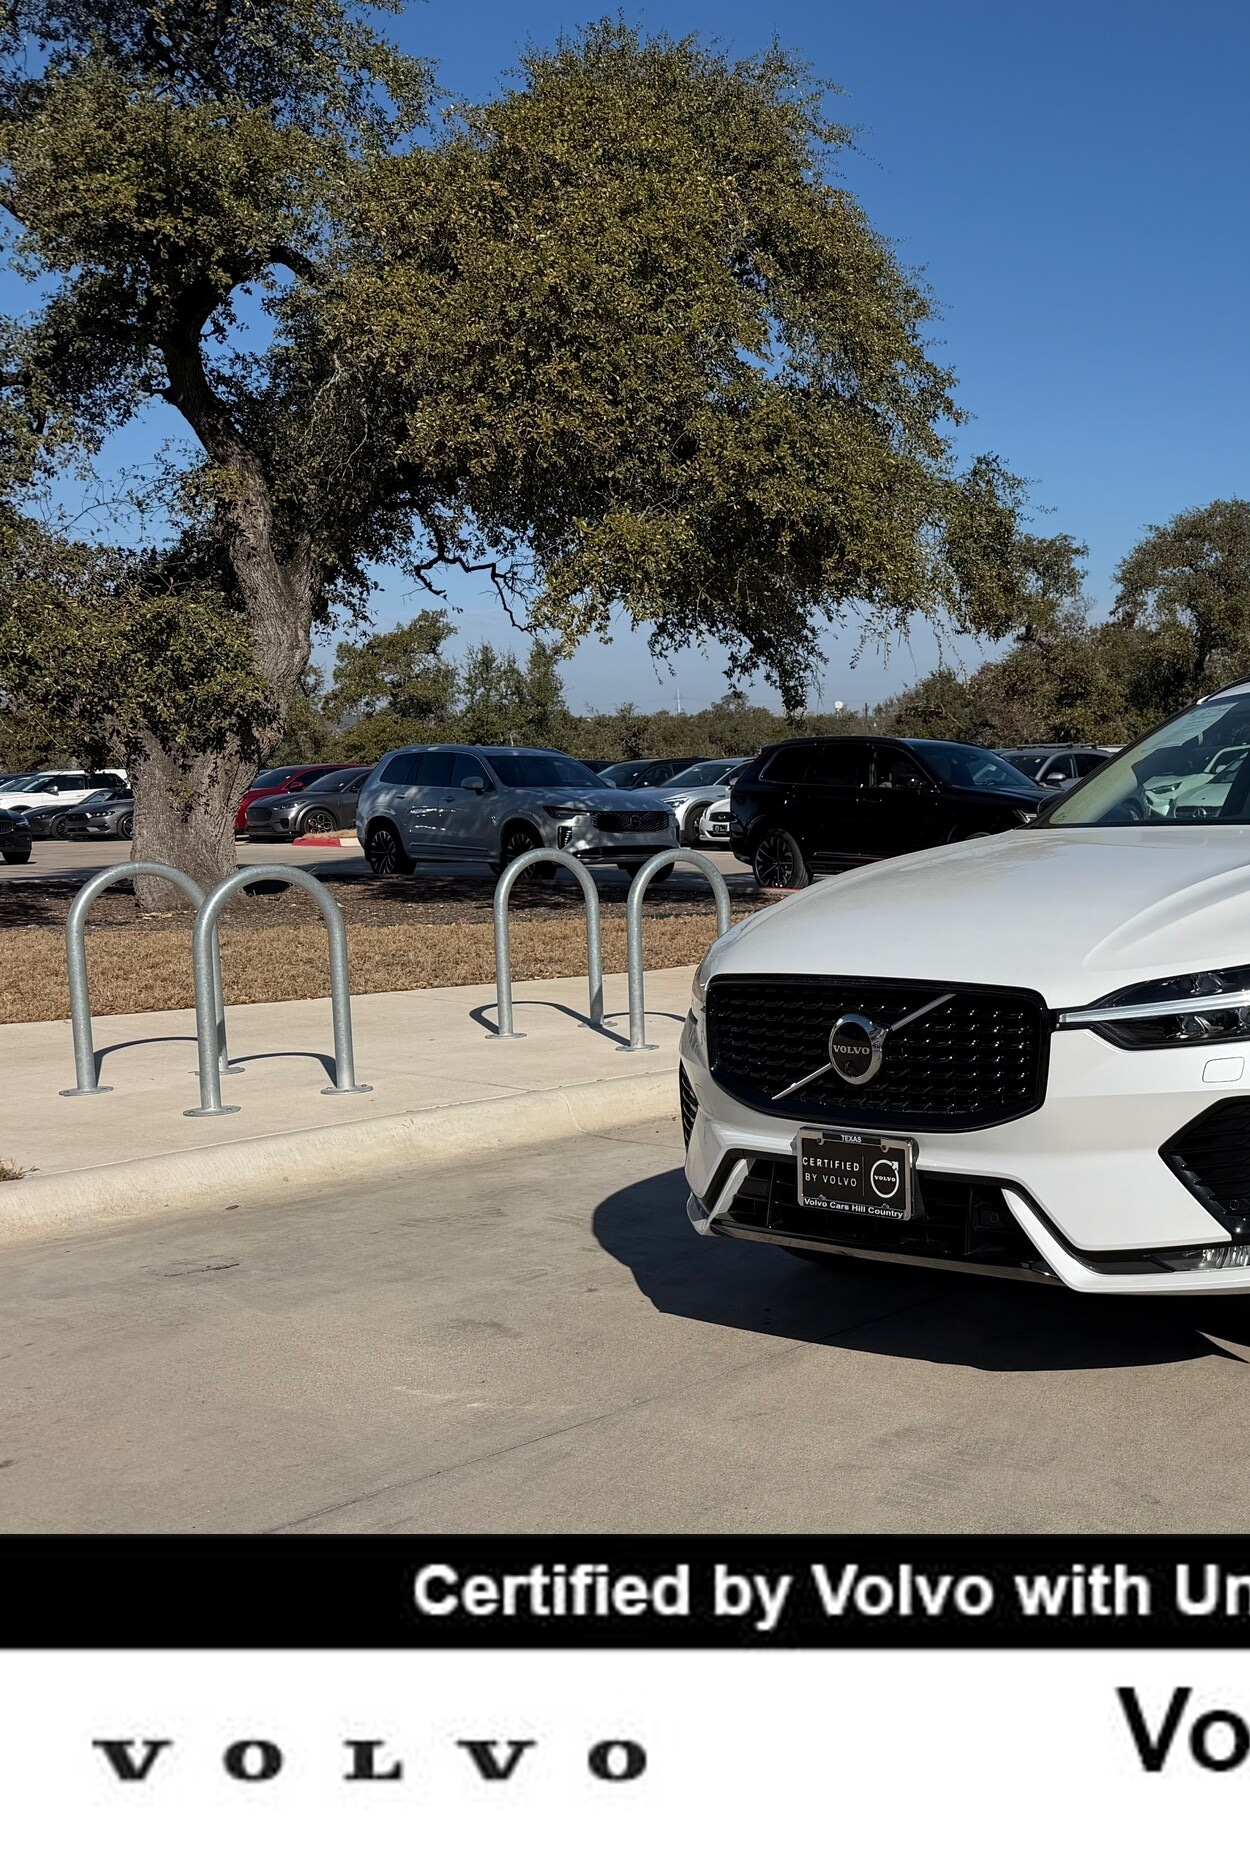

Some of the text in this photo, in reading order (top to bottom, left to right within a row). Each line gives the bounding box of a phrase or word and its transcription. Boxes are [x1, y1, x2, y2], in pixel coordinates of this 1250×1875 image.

[833, 1044, 870, 1055] VOLVO
[840, 1134, 862, 1143] TEXAS
[802, 1156, 860, 1171] CERTIFIED
[805, 1172, 857, 1187] BY VOLVO
[874, 1175, 896, 1183] VOLVO
[804, 1198, 904, 1219] Volvo Cars Hill Country
